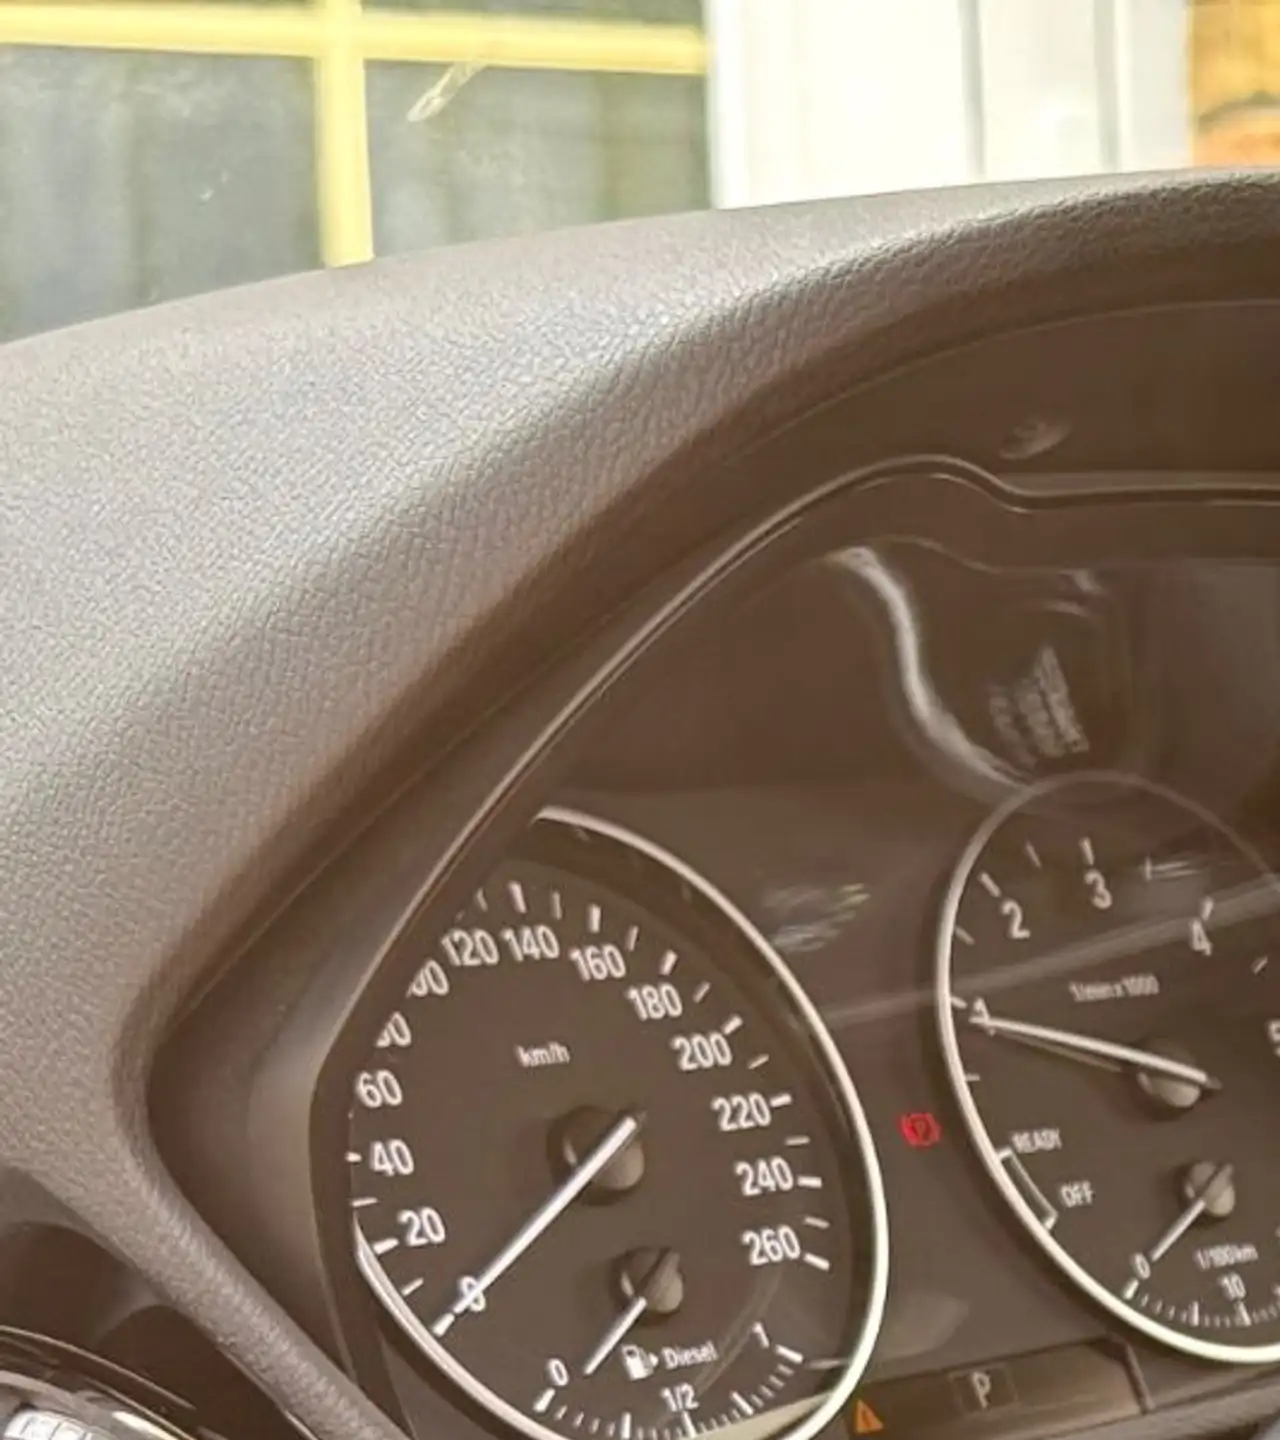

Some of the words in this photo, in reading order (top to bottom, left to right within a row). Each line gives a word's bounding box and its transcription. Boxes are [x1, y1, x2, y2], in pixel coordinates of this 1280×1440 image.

[1085, 868, 1112, 909] 3
[1002, 899, 1031, 939] 2
[1189, 919, 1213, 956] 4
[440, 929, 500, 967] 120
[504, 925, 559, 961] 140
[571, 945, 627, 982] 160
[627, 985, 683, 1021] 180
[517, 1041, 571, 1068] km/h
[673, 1032, 732, 1072] 200
[355, 1070, 403, 1107] 60
[712, 1093, 771, 1132] 220
[369, 1140, 415, 1177] 40
[1011, 1128, 1063, 1154] READY
[735, 1157, 794, 1197] 240
[1061, 1180, 1094, 1208] OFF
[401, 1206, 446, 1246] 20
[741, 1225, 801, 1267] 260
[1134, 1252, 1151, 1279] 0
[1220, 1272, 1247, 1301] 10
[751, 1322, 770, 1348] 1
[546, 1358, 569, 1388] 0
[663, 1341, 718, 1370] Diesel
[661, 1382, 699, 1412] 1/2
[972, 1371, 992, 1409] P
